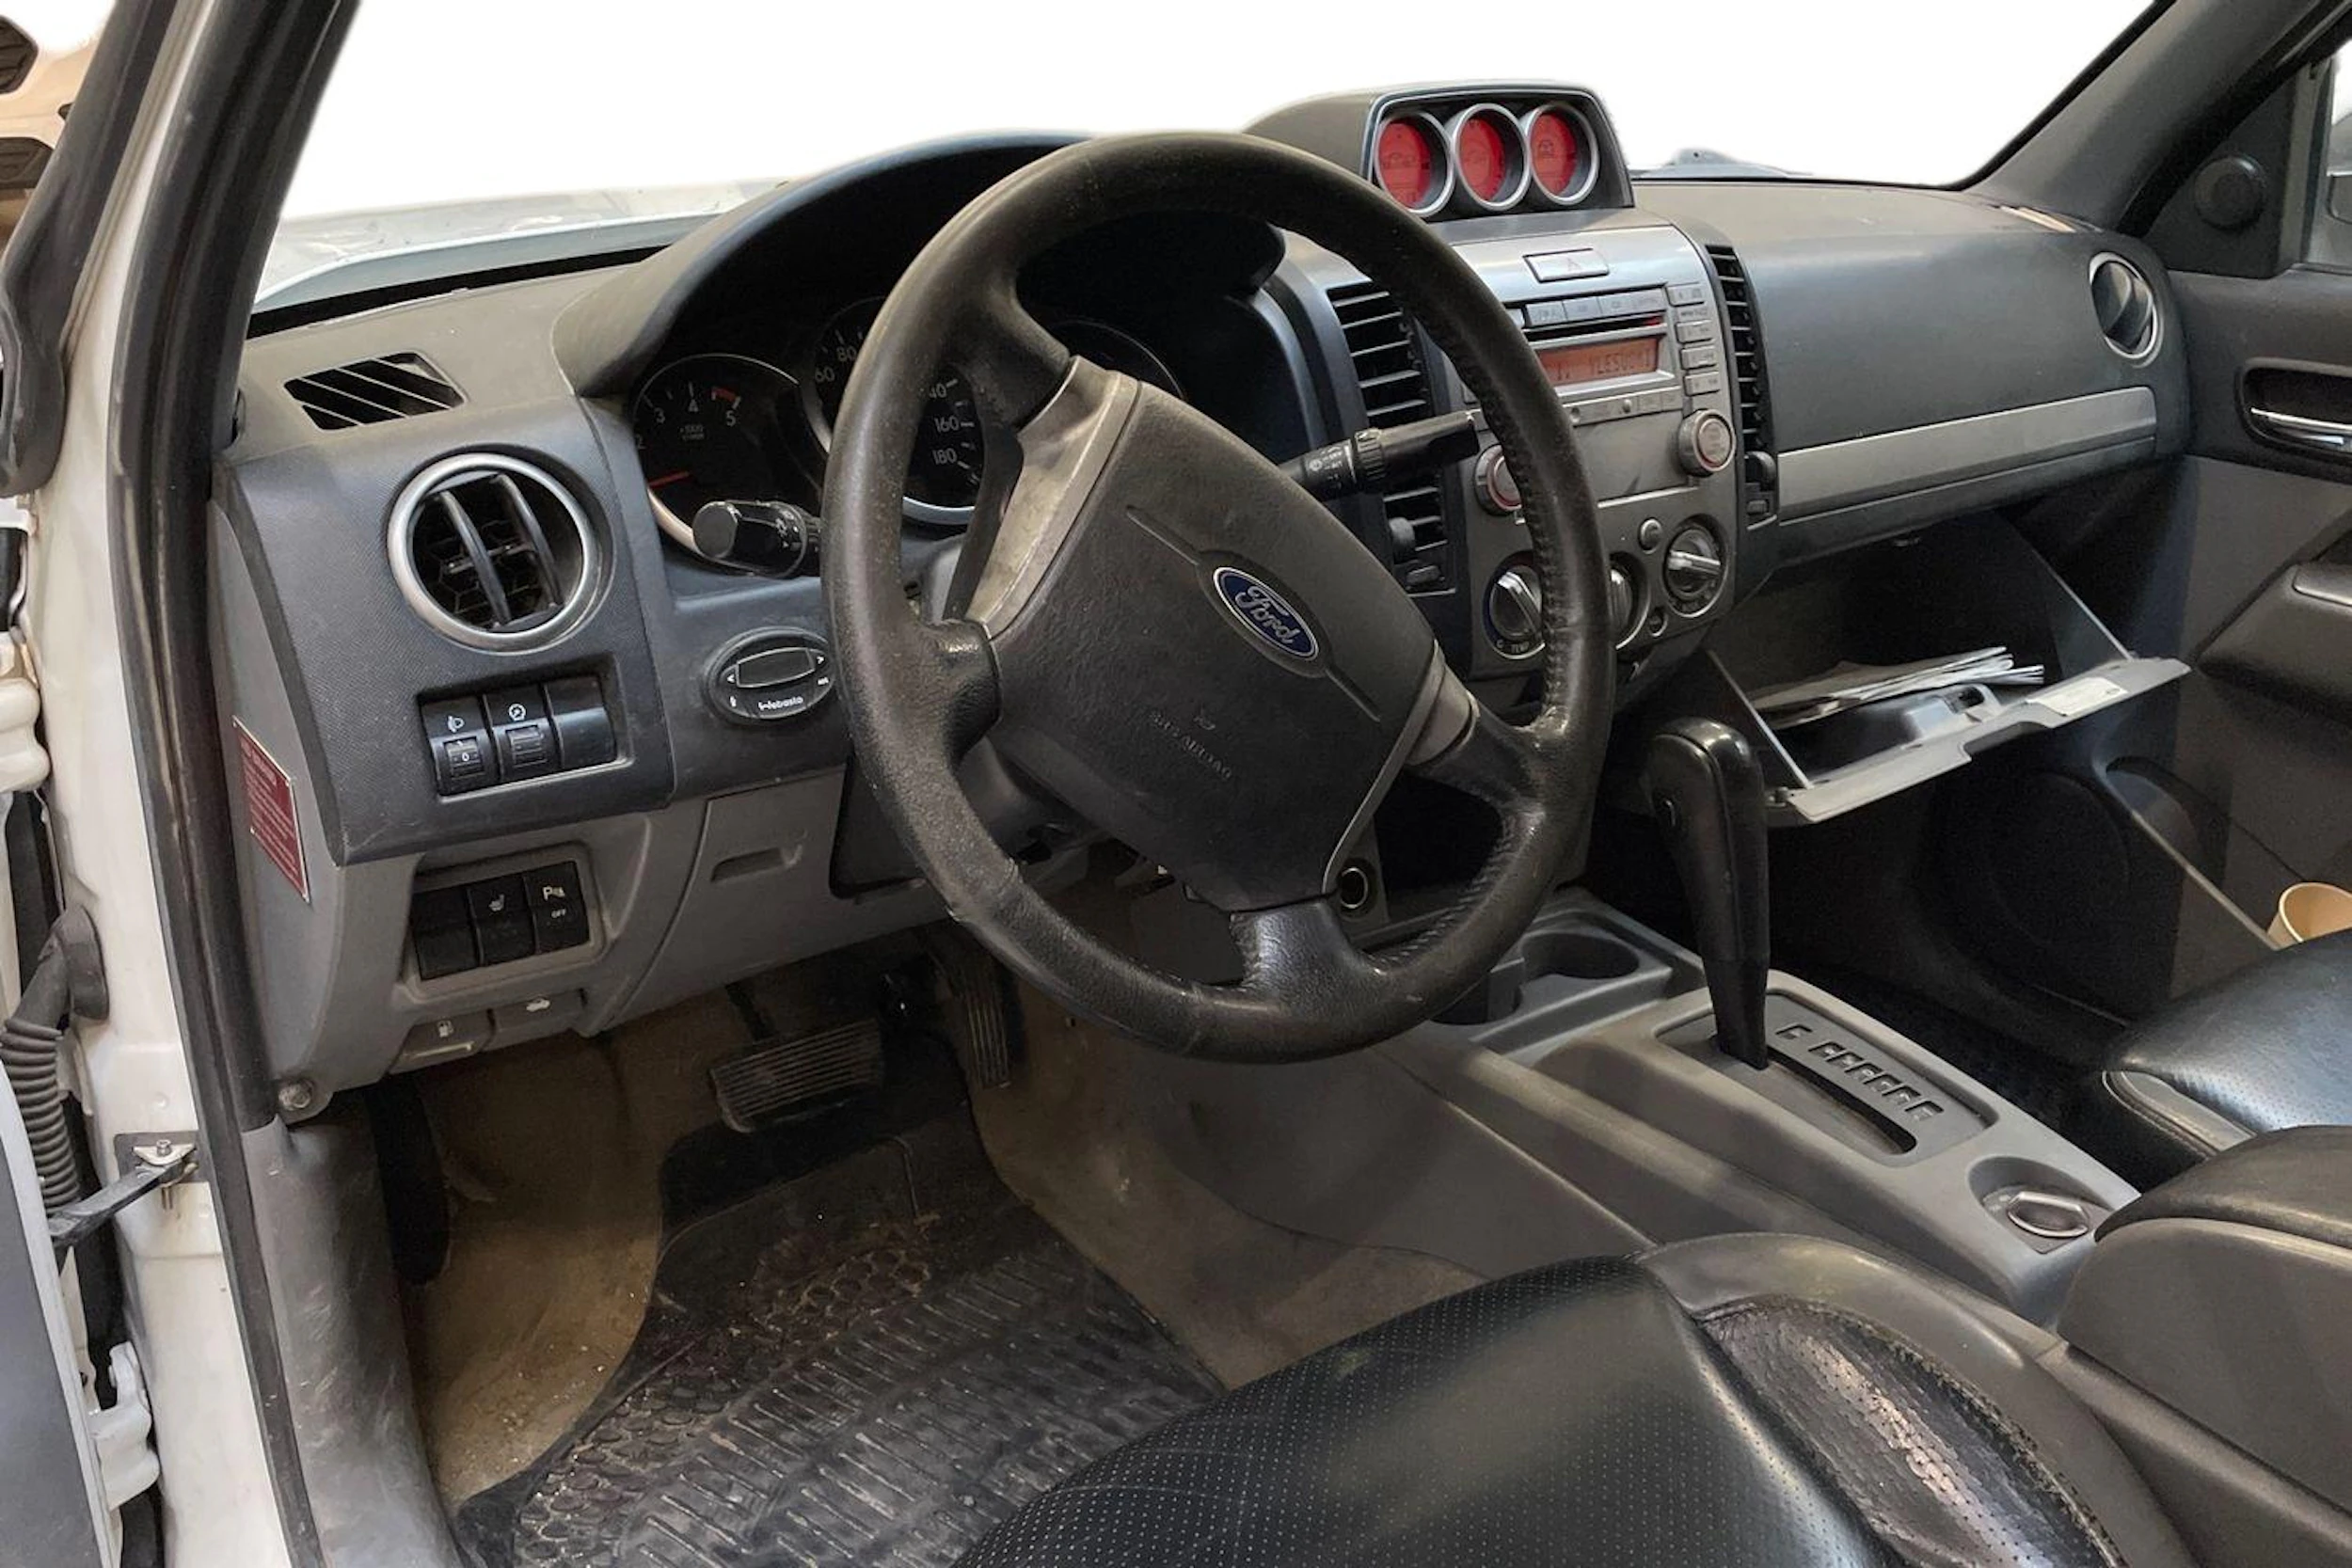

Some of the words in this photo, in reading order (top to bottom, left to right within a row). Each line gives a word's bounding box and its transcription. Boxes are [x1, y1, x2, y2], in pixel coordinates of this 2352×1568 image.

[836, 345, 857, 363] 80
[815, 366, 835, 385] 60
[653, 406, 666, 425] 3
[688, 398, 700, 414] 4
[725, 409, 737, 428] 5
[934, 415, 959, 434] 160
[932, 448, 958, 465] 180
[1234, 585, 1301, 644] Ford
